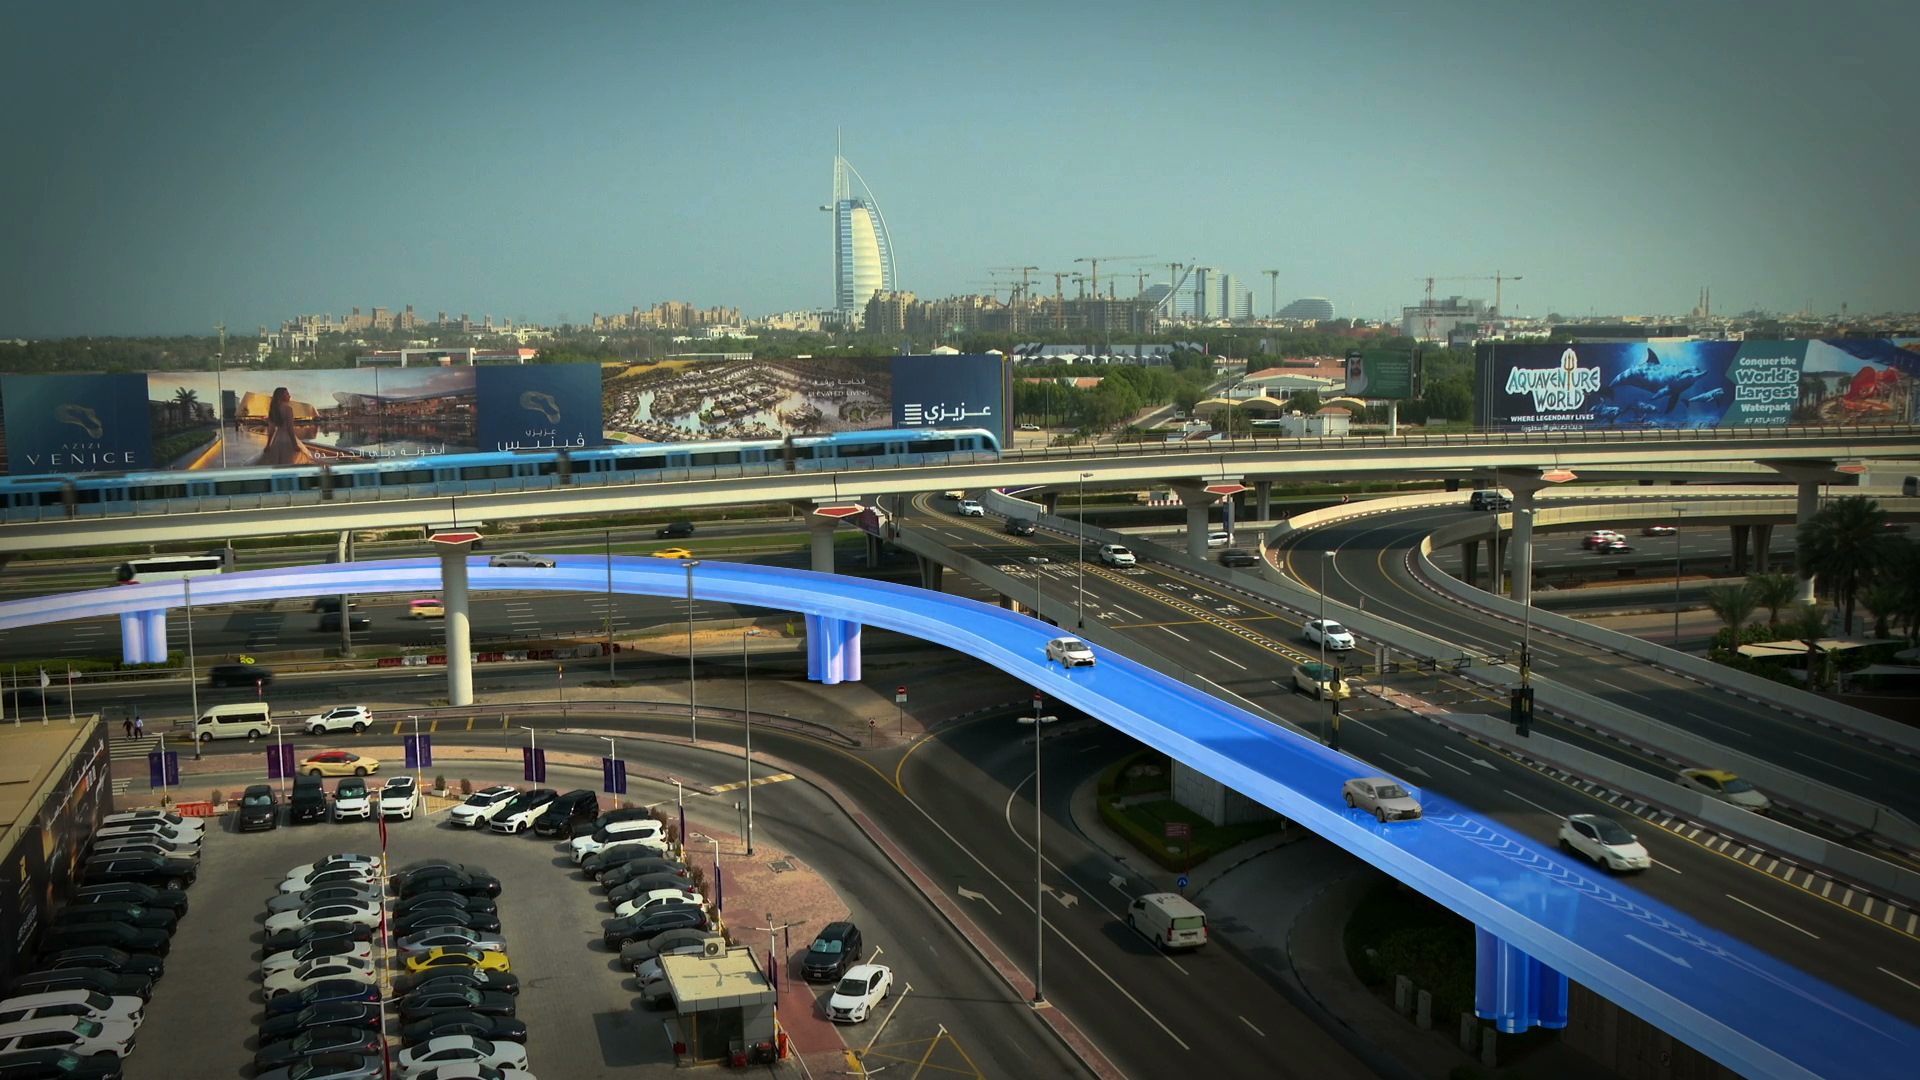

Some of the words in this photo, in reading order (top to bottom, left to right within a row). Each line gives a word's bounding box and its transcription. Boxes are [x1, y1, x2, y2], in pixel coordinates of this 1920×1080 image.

[1740, 357, 1779, 367] Conquer
[1781, 356, 1797, 365] the
[1506, 366, 1600, 394] AQUAVENTURE
[1735, 367, 1799, 384] World's
[1533, 389, 1585, 412] WORLD
[1735, 384, 1799, 403] Largest
[924, 402, 991, 425] عزيزي
[1740, 402, 1791, 413] Waterpark
[26, 452, 136, 466] VENICE
